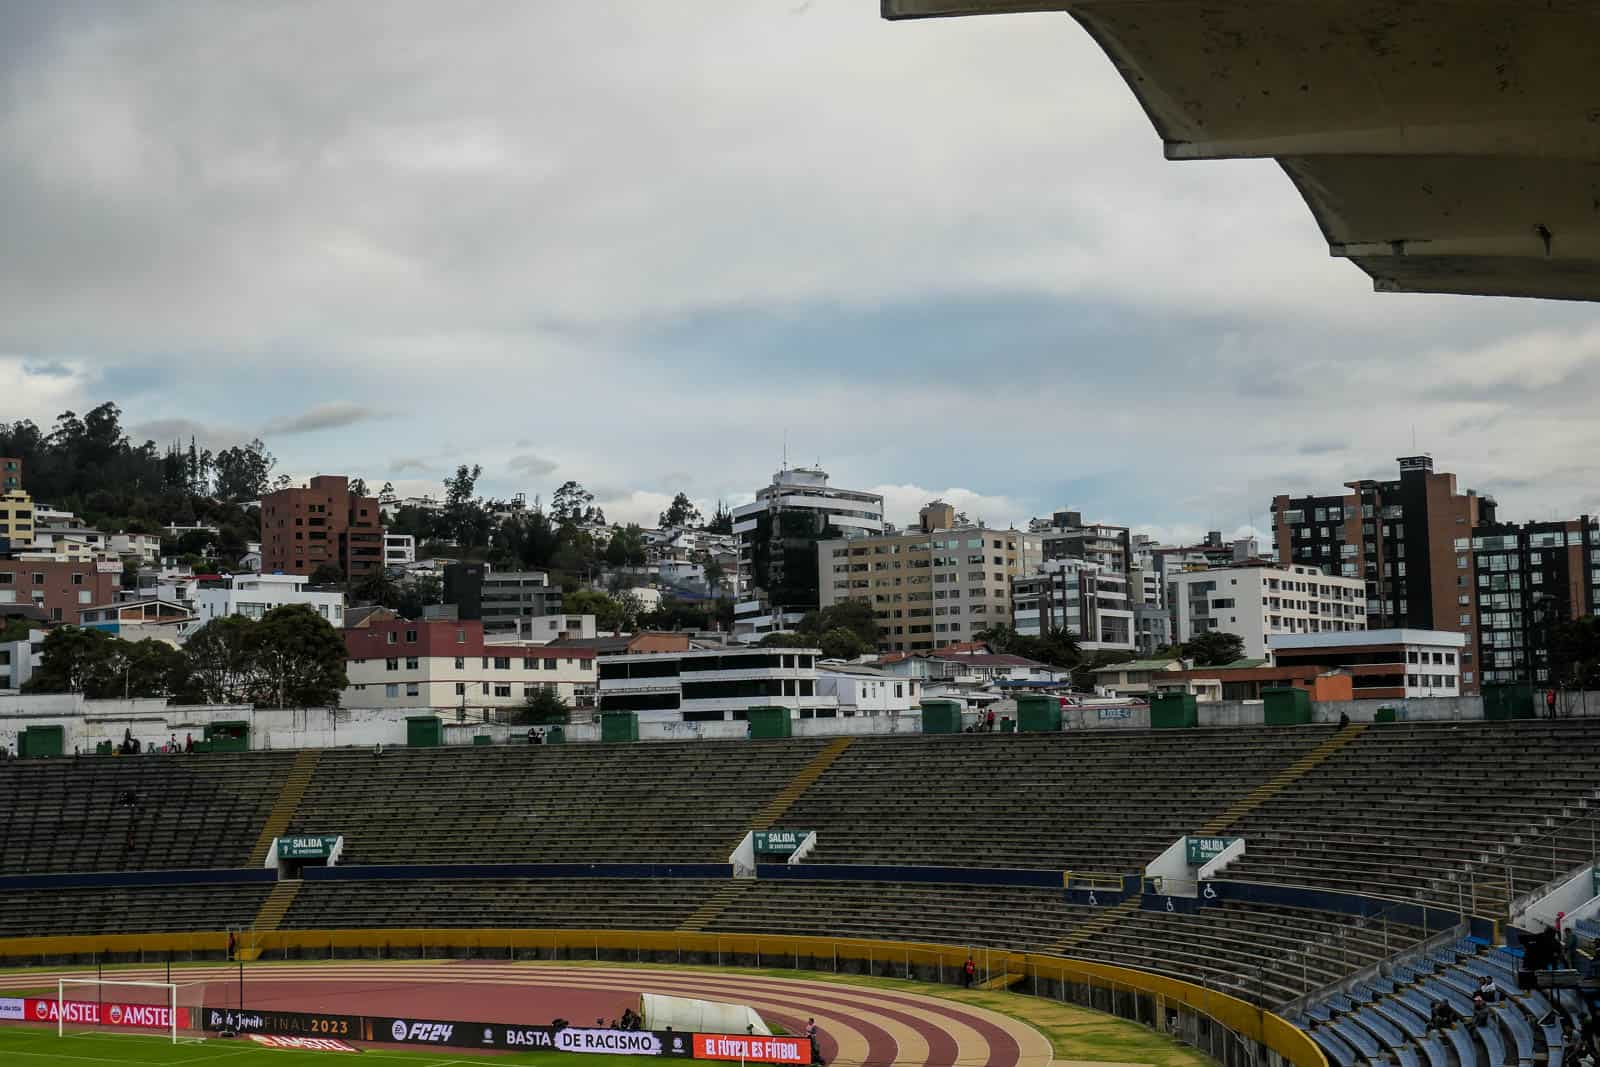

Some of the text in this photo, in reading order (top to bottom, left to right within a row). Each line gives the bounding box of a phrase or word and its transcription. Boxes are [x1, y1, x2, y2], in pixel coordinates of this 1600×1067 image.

[292, 838, 322, 848] SALIDA
[768, 832, 796, 842] SALIDA
[1200, 839, 1224, 850] SALIDA
[50, 1001, 100, 1022] AMSTEL
[123, 1006, 174, 1026] AMSTEL
[264, 1016, 309, 1032] FINAL
[311, 1019, 348, 1034] 2023
[506, 1030, 652, 1050] BASTA DE RACISMO
[705, 1038, 716, 1055] EL
[751, 1040, 763, 1058] ES
[765, 1037, 800, 1060] FÚTBOL
